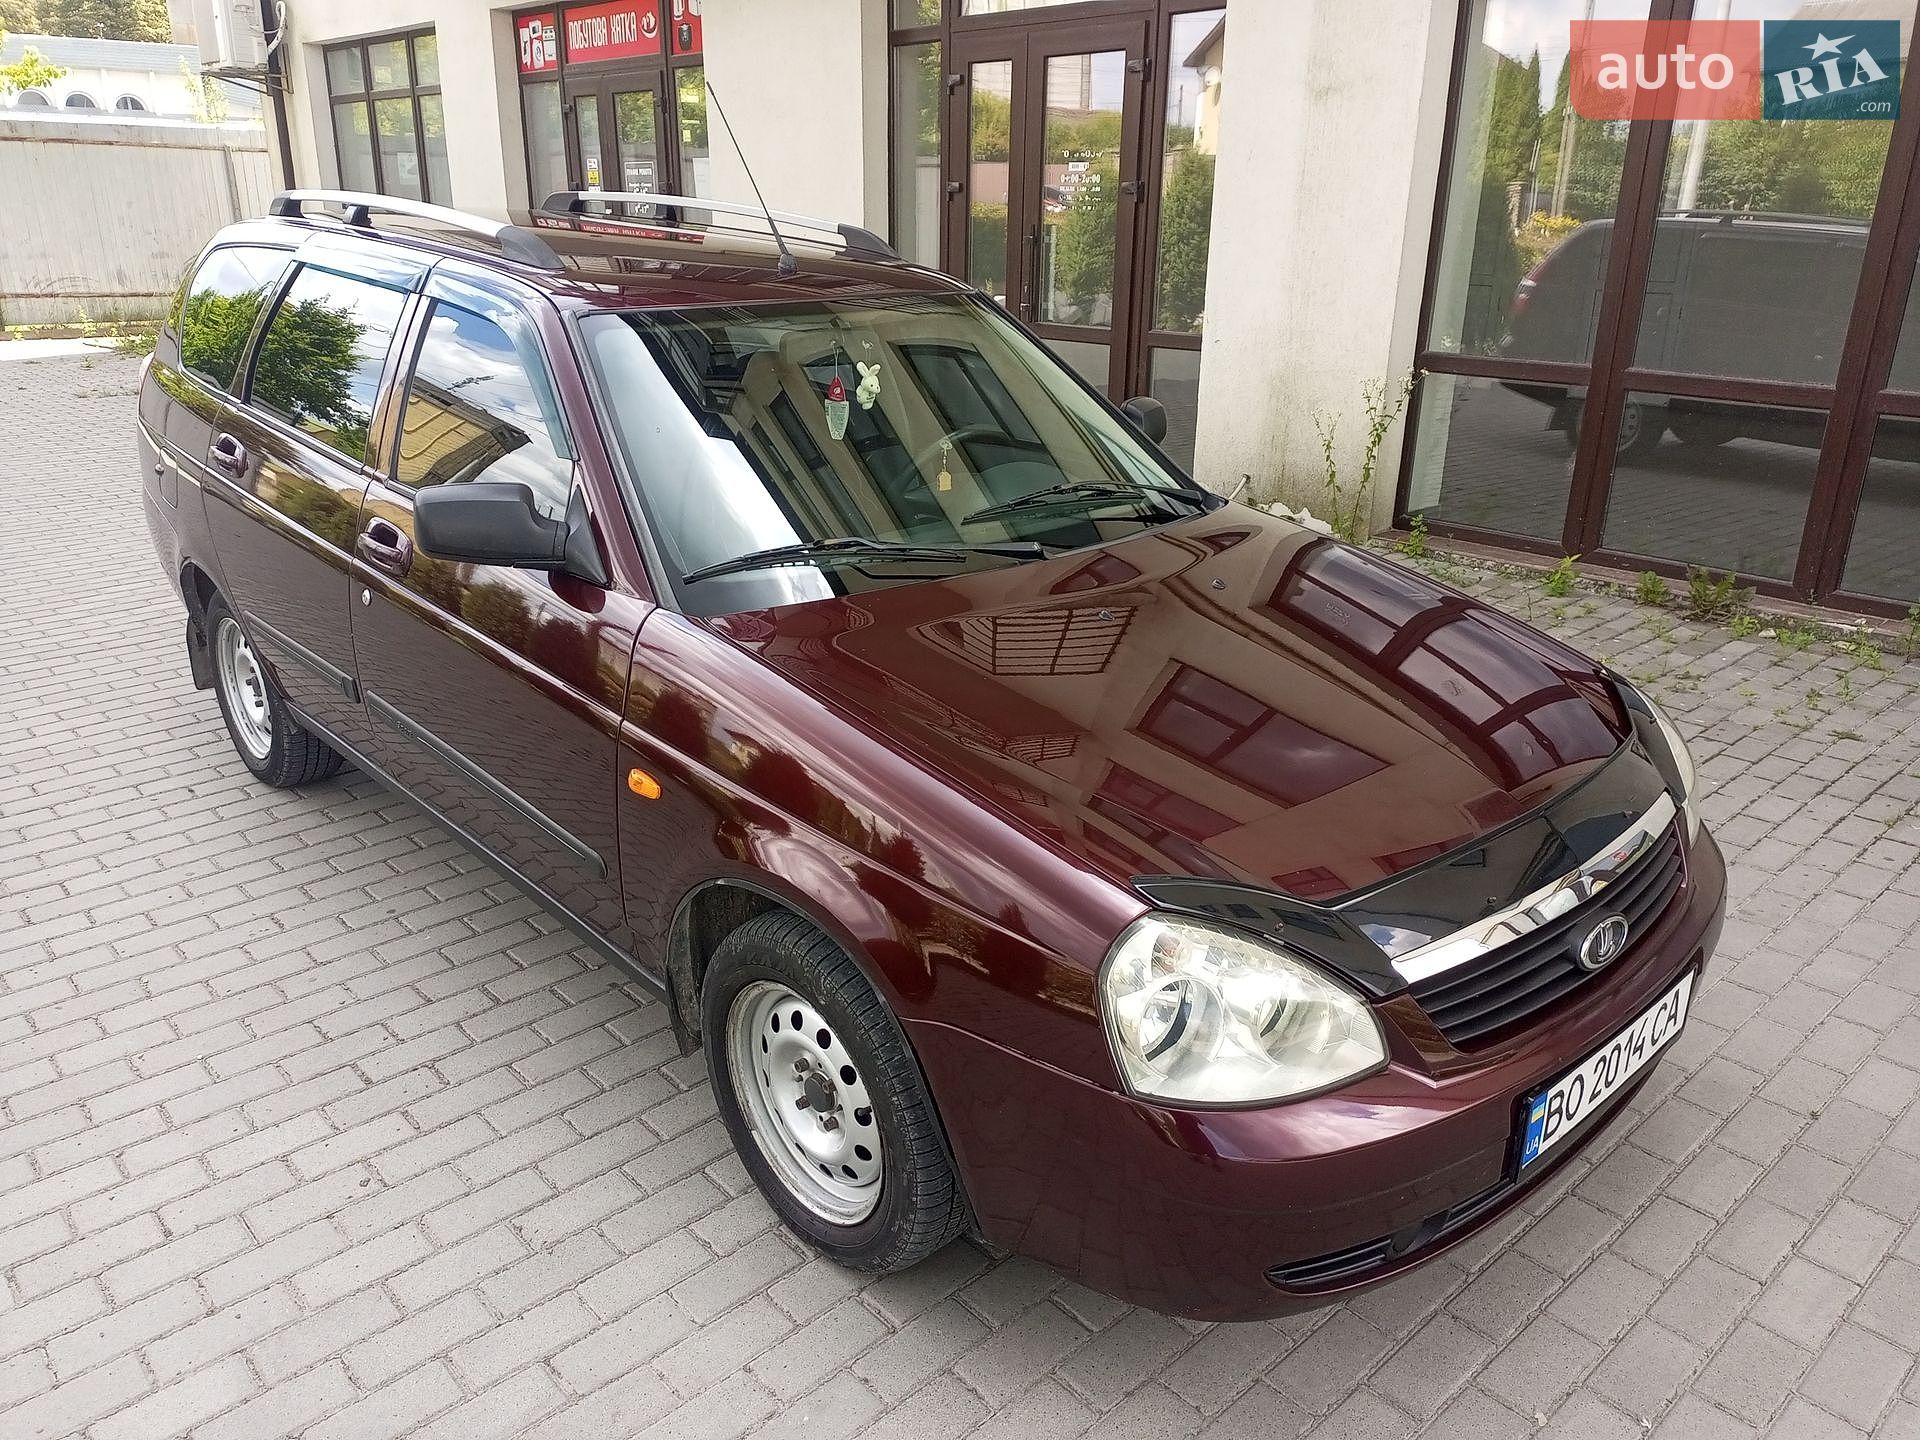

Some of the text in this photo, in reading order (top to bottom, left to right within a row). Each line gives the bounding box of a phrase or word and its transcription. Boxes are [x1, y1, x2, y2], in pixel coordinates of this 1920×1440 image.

[568, 12, 637, 50] ПОБУТОВА ХАТКА
[1543, 988, 1680, 1139] BO 2014 CA
[1526, 1140, 1539, 1154] UA
